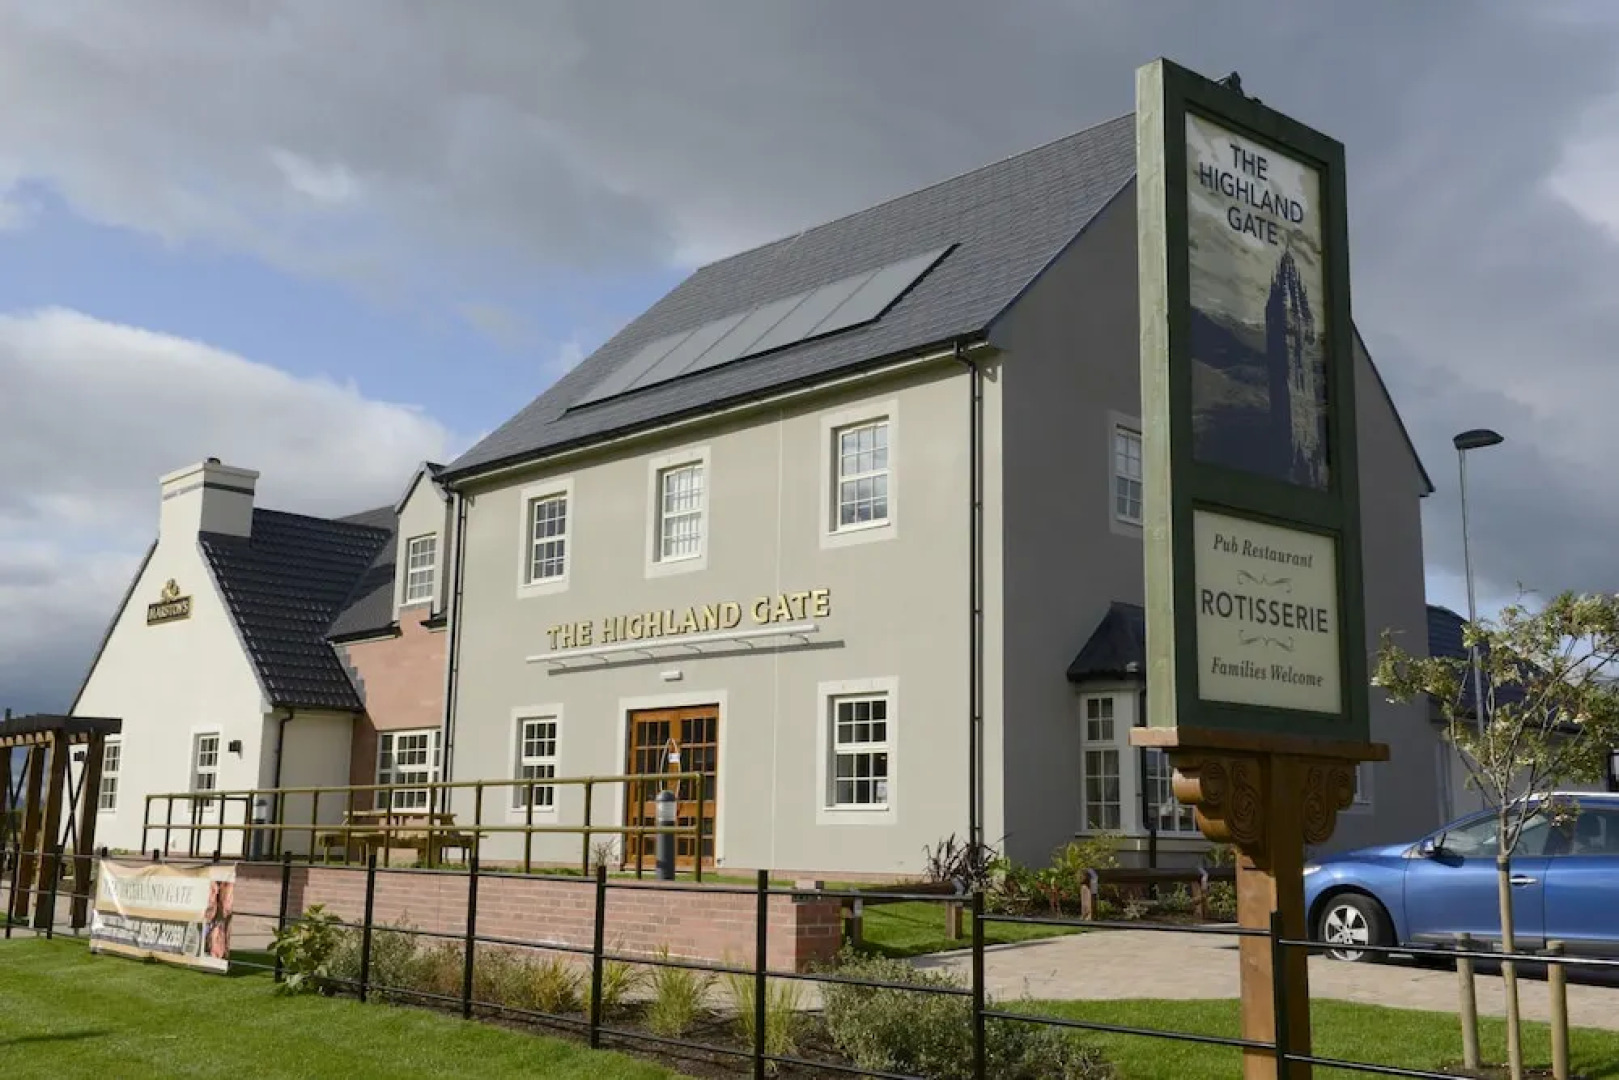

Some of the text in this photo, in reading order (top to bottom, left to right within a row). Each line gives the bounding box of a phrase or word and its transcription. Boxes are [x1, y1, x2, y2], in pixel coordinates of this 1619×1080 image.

[1230, 143, 1268, 181] THE
[1199, 161, 1304, 223] HIGHLAND
[1227, 206, 1278, 246] GATE
[1213, 533, 1313, 568] Pub Restaurant
[547, 588, 831, 649] THE HIGHLAND GATE
[1202, 589, 1328, 633] ROTISSERIE
[1211, 656, 1324, 687] Families Welcome
